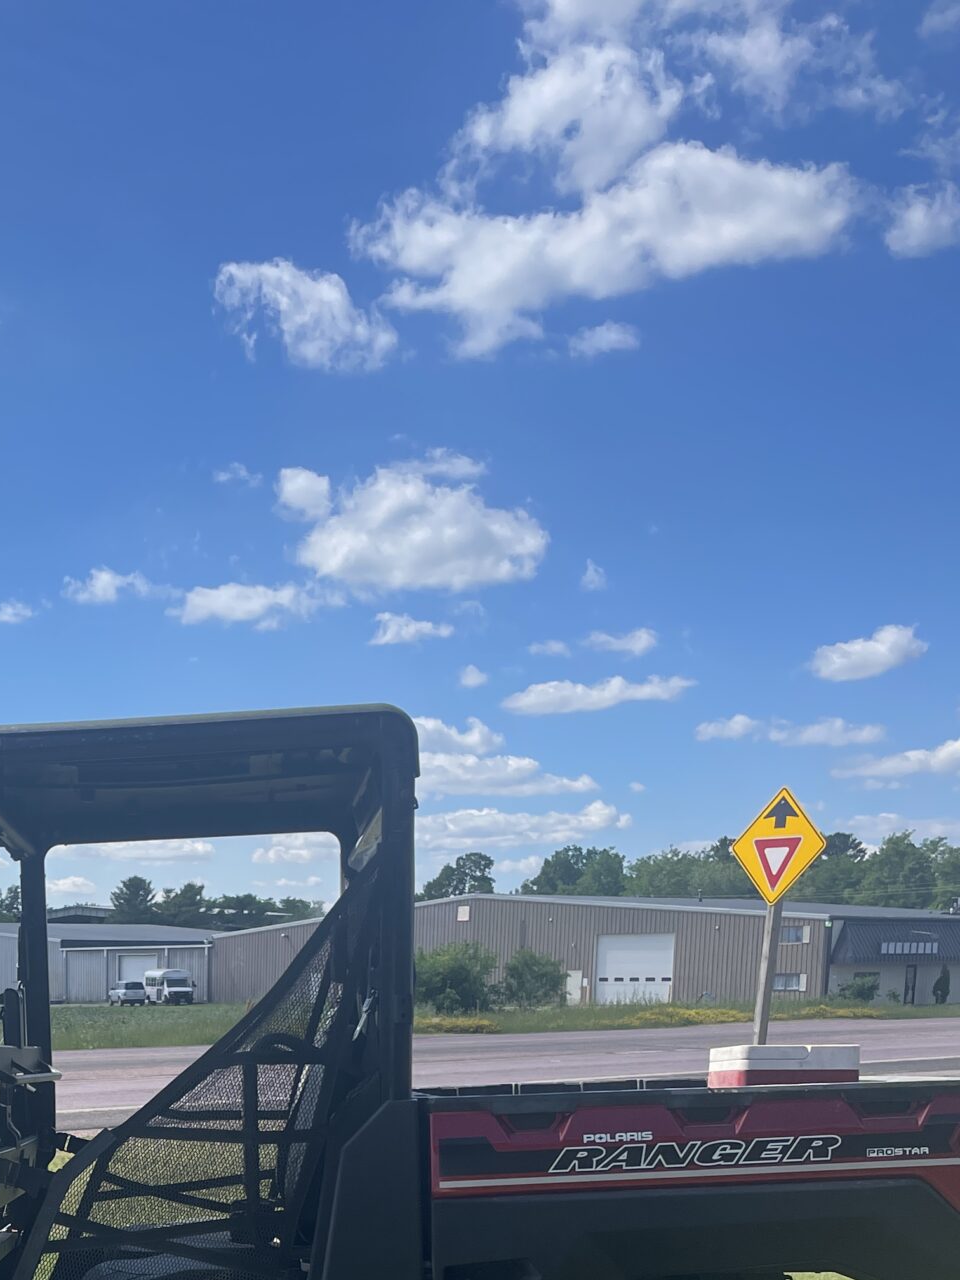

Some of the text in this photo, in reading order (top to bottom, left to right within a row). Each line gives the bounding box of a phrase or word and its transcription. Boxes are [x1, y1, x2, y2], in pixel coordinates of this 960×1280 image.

[583, 1131, 653, 1143] POLARIS
[548, 1135, 841, 1174] RANGER
[867, 1147, 929, 1157] PROSTAR
